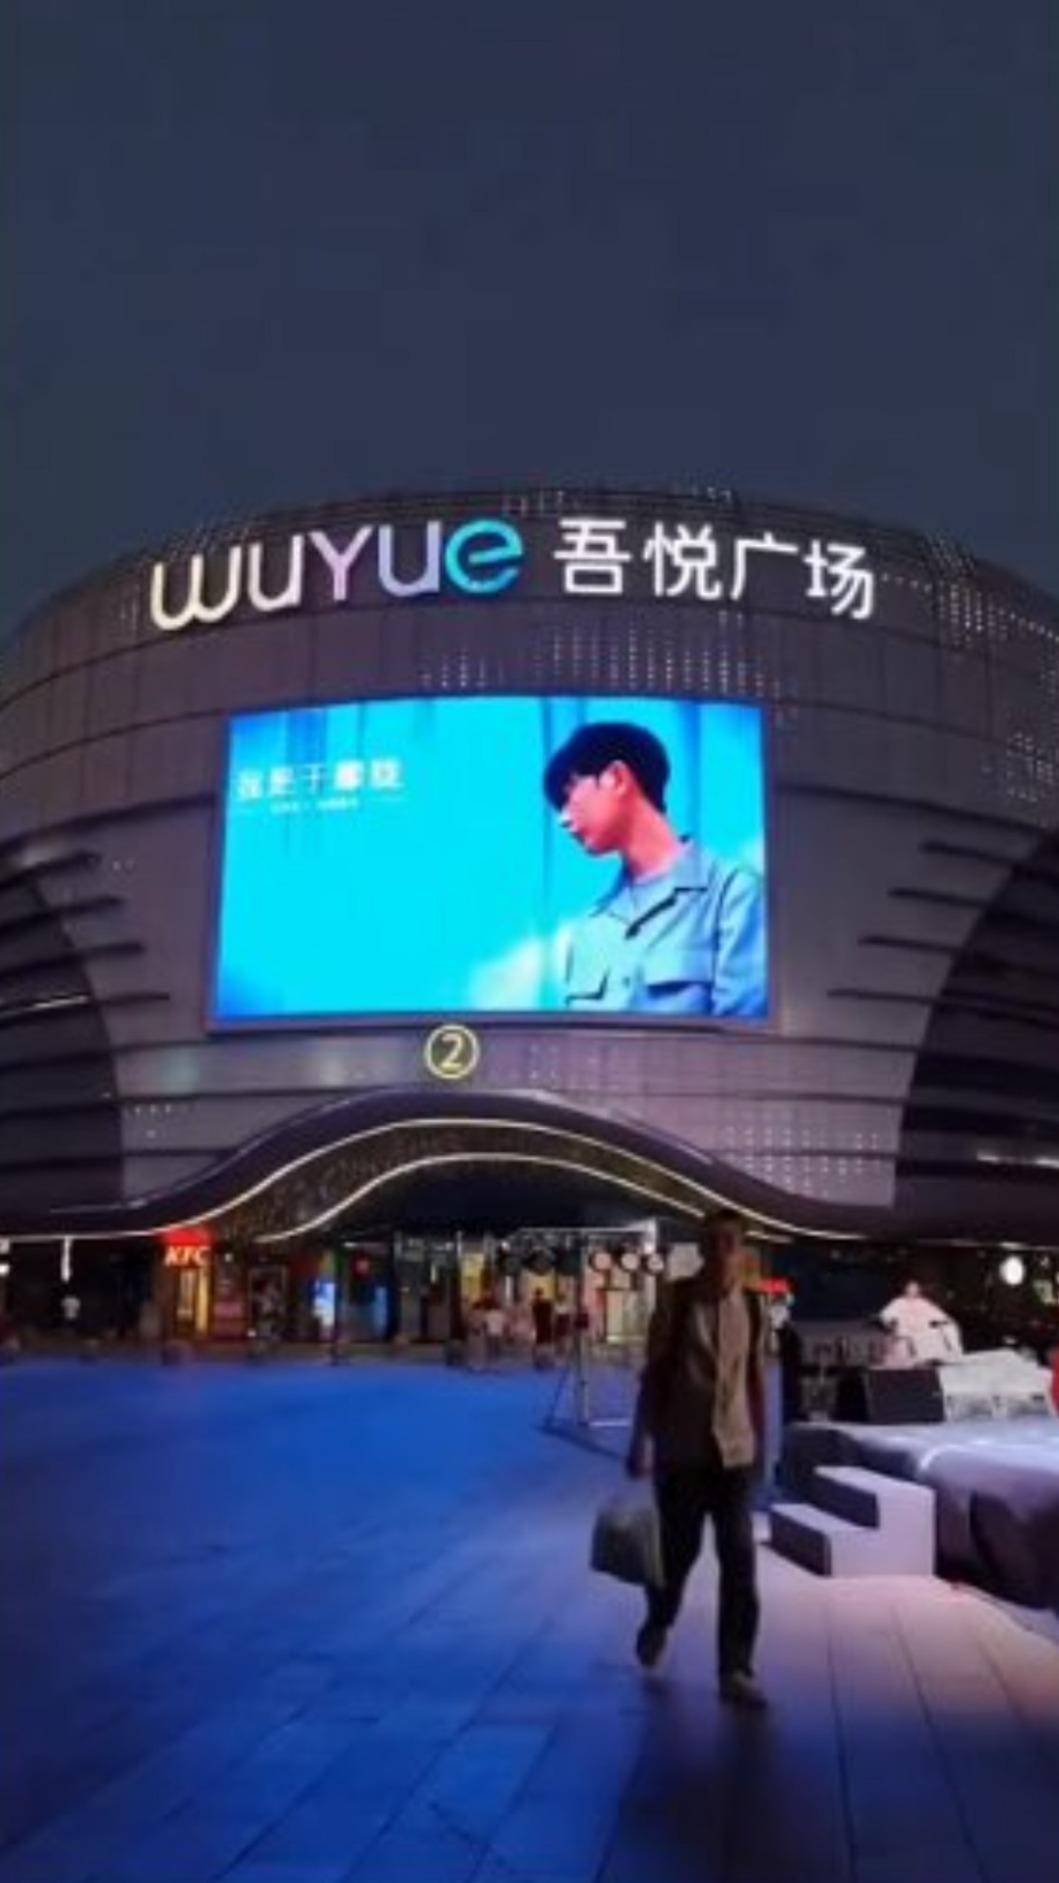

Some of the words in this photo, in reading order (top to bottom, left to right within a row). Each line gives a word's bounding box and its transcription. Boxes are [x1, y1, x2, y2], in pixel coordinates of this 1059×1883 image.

[553, 519, 874, 620] 吾悦广场
[165, 1245, 210, 1266] KFC
